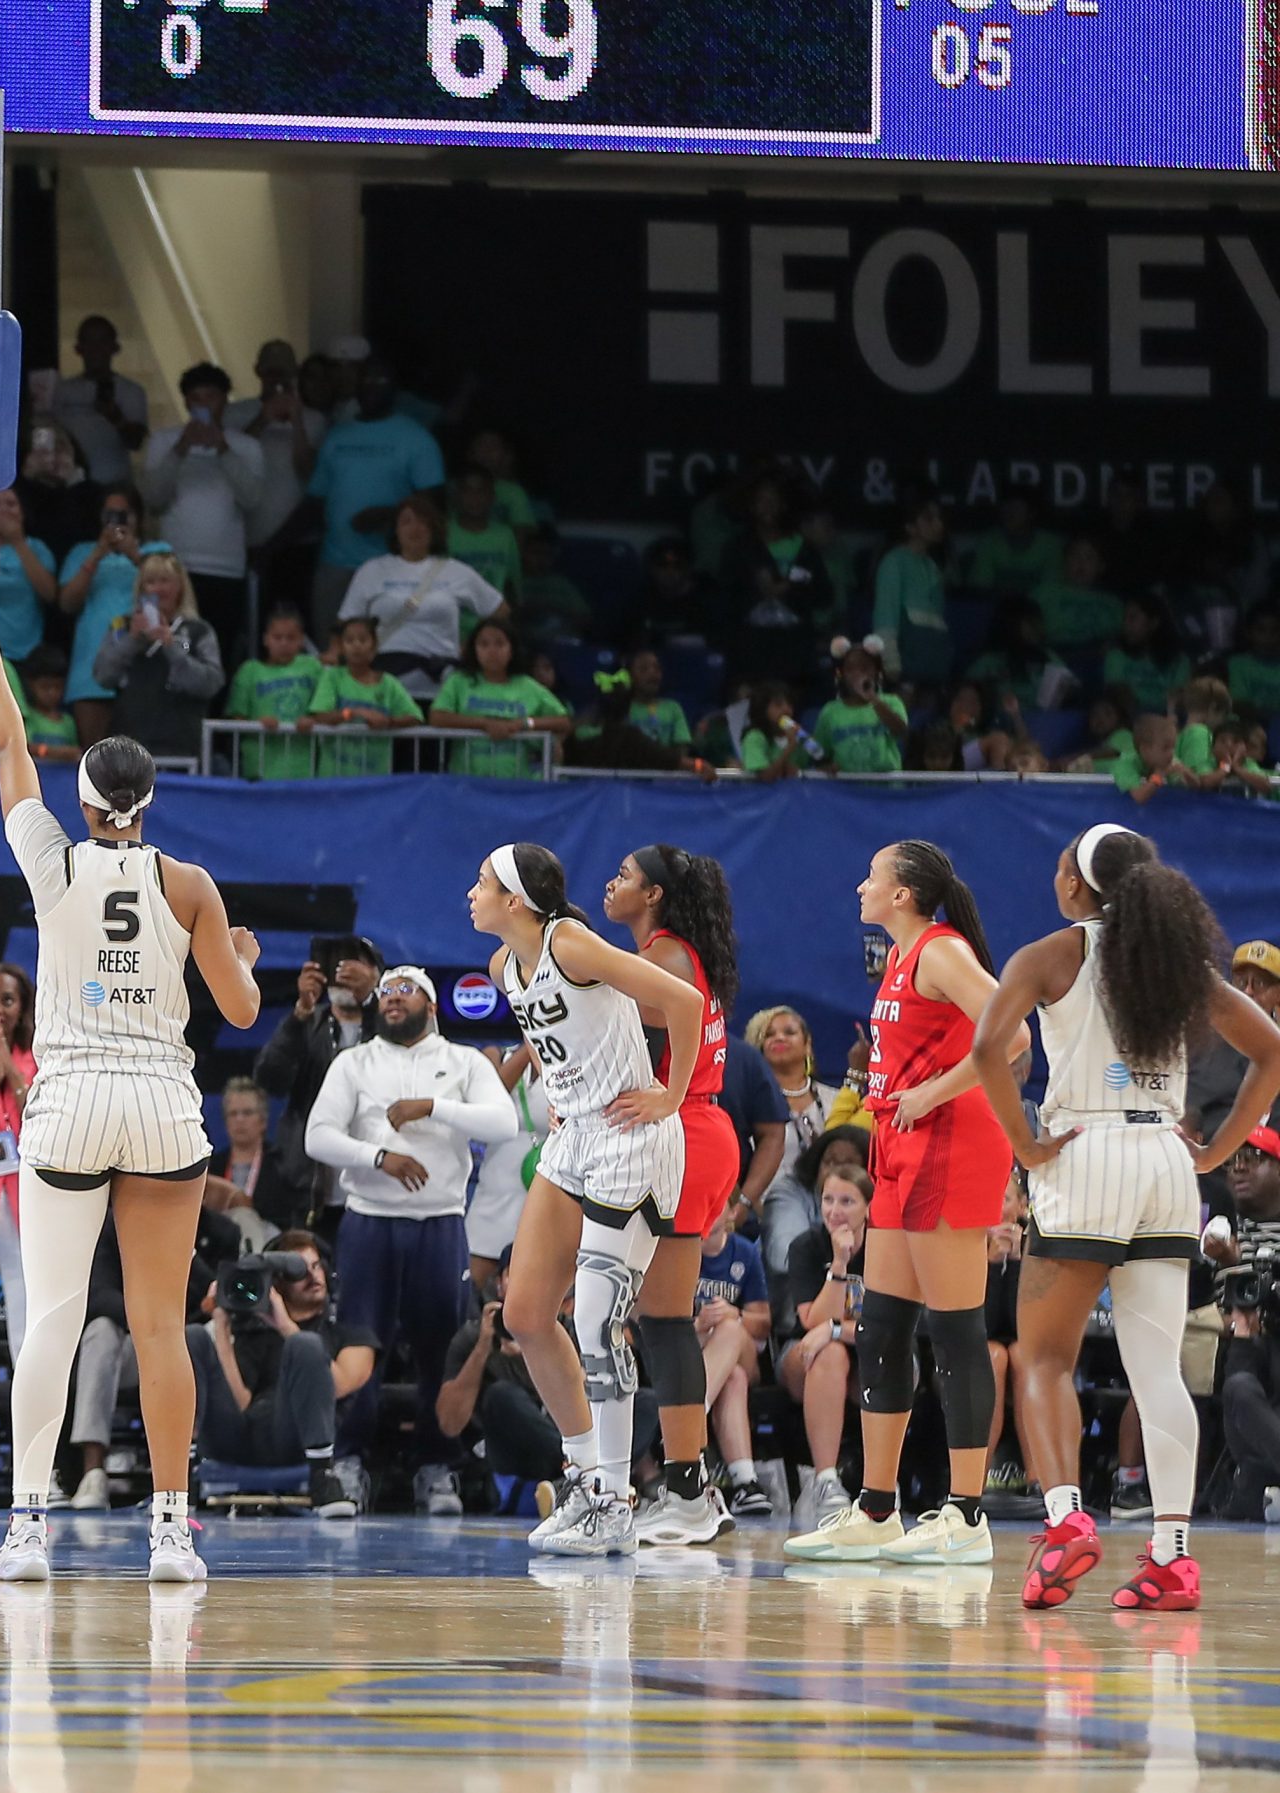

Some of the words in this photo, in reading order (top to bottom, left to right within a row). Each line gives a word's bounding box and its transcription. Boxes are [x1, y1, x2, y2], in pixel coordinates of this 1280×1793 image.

[161, 12, 201, 78] 0
[427, 0, 598, 101] 69
[931, 21, 1011, 90] 05
[101, 889, 141, 944] 5
[97, 949, 141, 974] REESE
[109, 987, 156, 1005] AT&T
[512, 991, 569, 1031] SKY
[531, 1035, 567, 1065] 20
